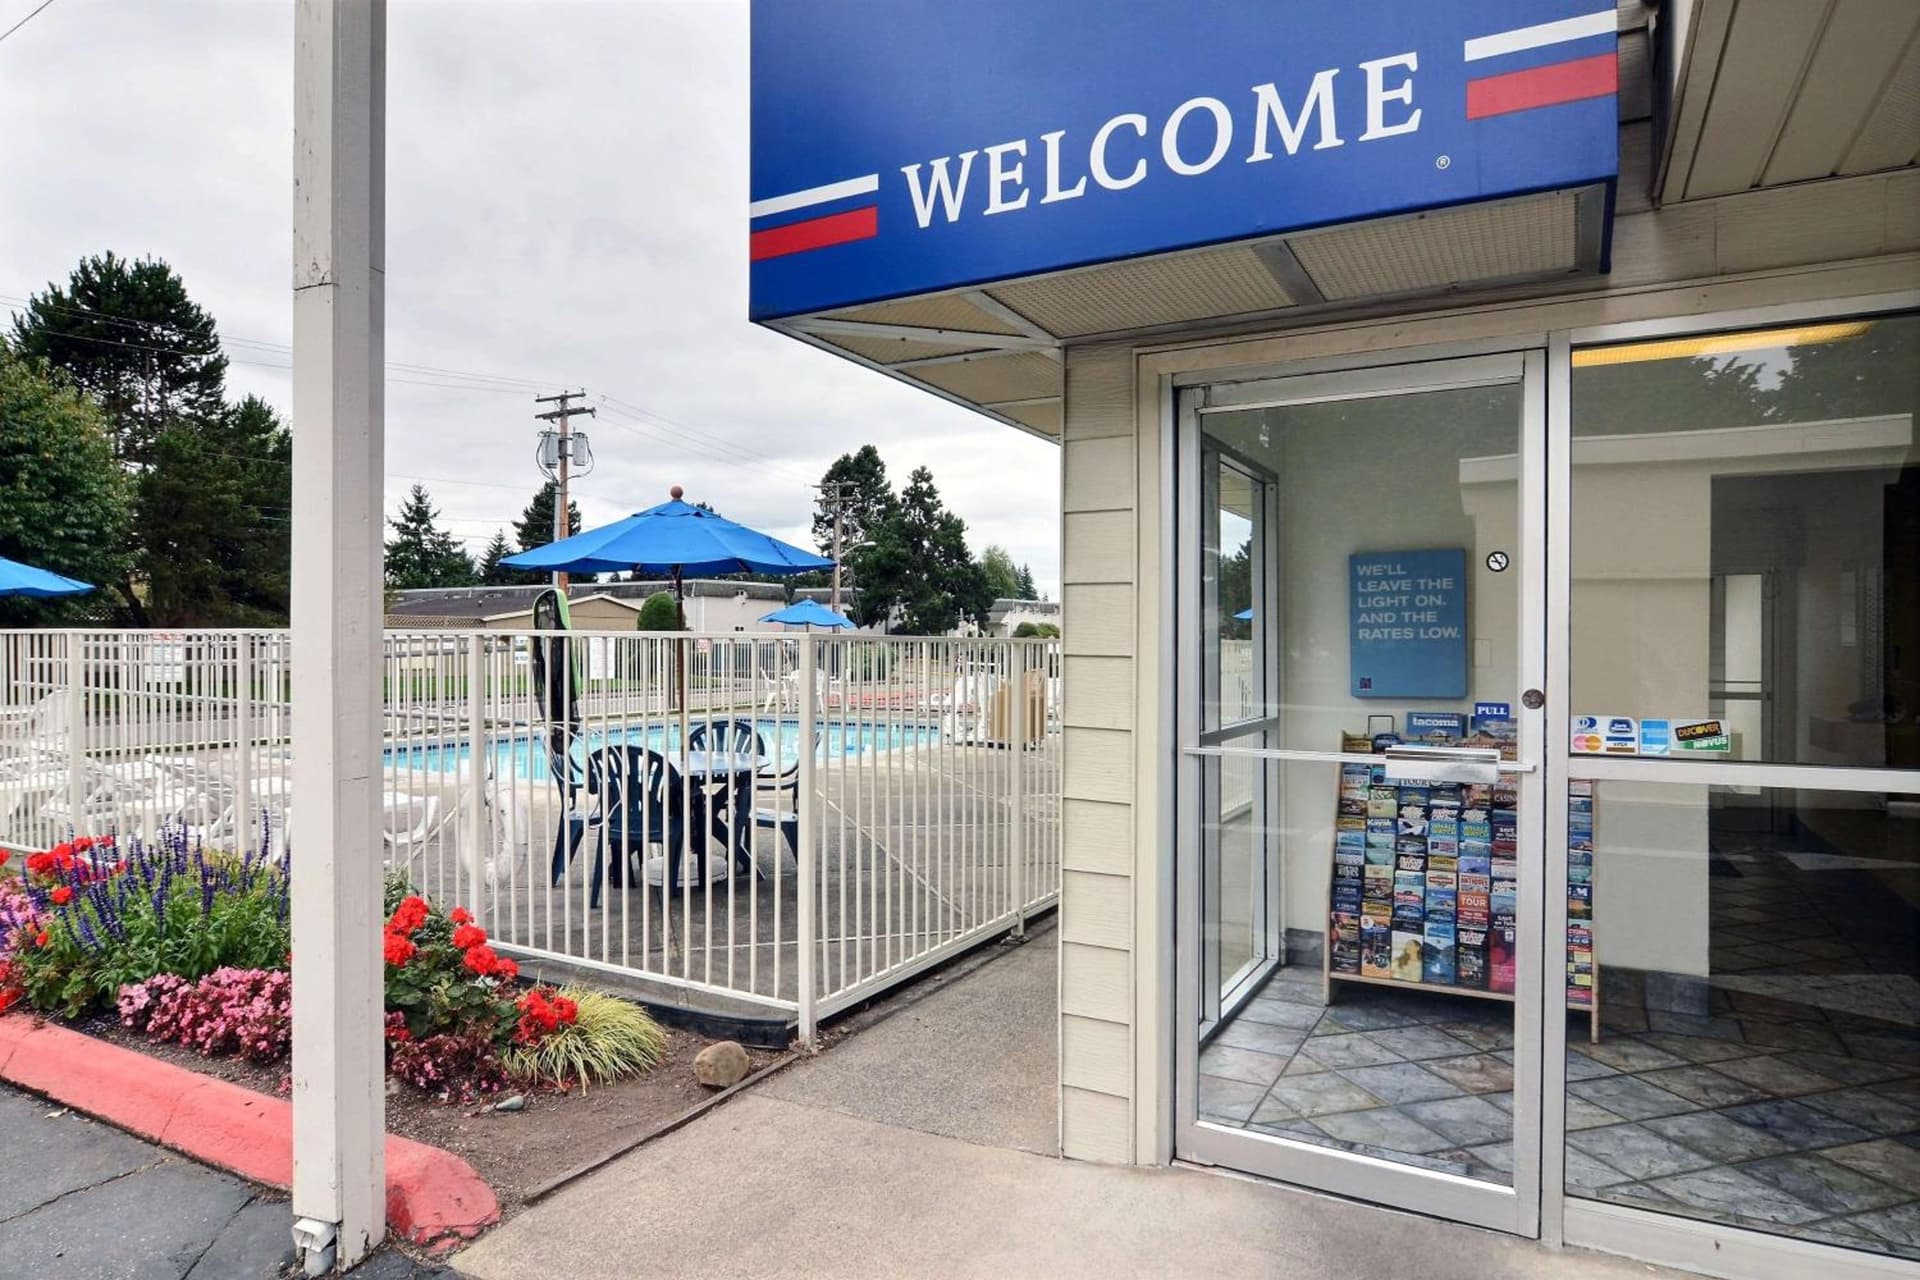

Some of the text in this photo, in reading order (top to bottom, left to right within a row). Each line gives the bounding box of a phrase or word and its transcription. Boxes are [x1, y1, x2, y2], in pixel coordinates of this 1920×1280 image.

[900, 51, 1422, 229] WELCOME
[1357, 564, 1407, 576] WE'LL
[1358, 578, 1455, 592] LEAVE THE
[1358, 595, 1447, 608] LIGHT ON.
[1358, 611, 1439, 624] AND THE
[1359, 626, 1460, 639] RATES LOW.
[1477, 706, 1508, 715] PULL
[1461, 896, 1487, 907] TOUR
